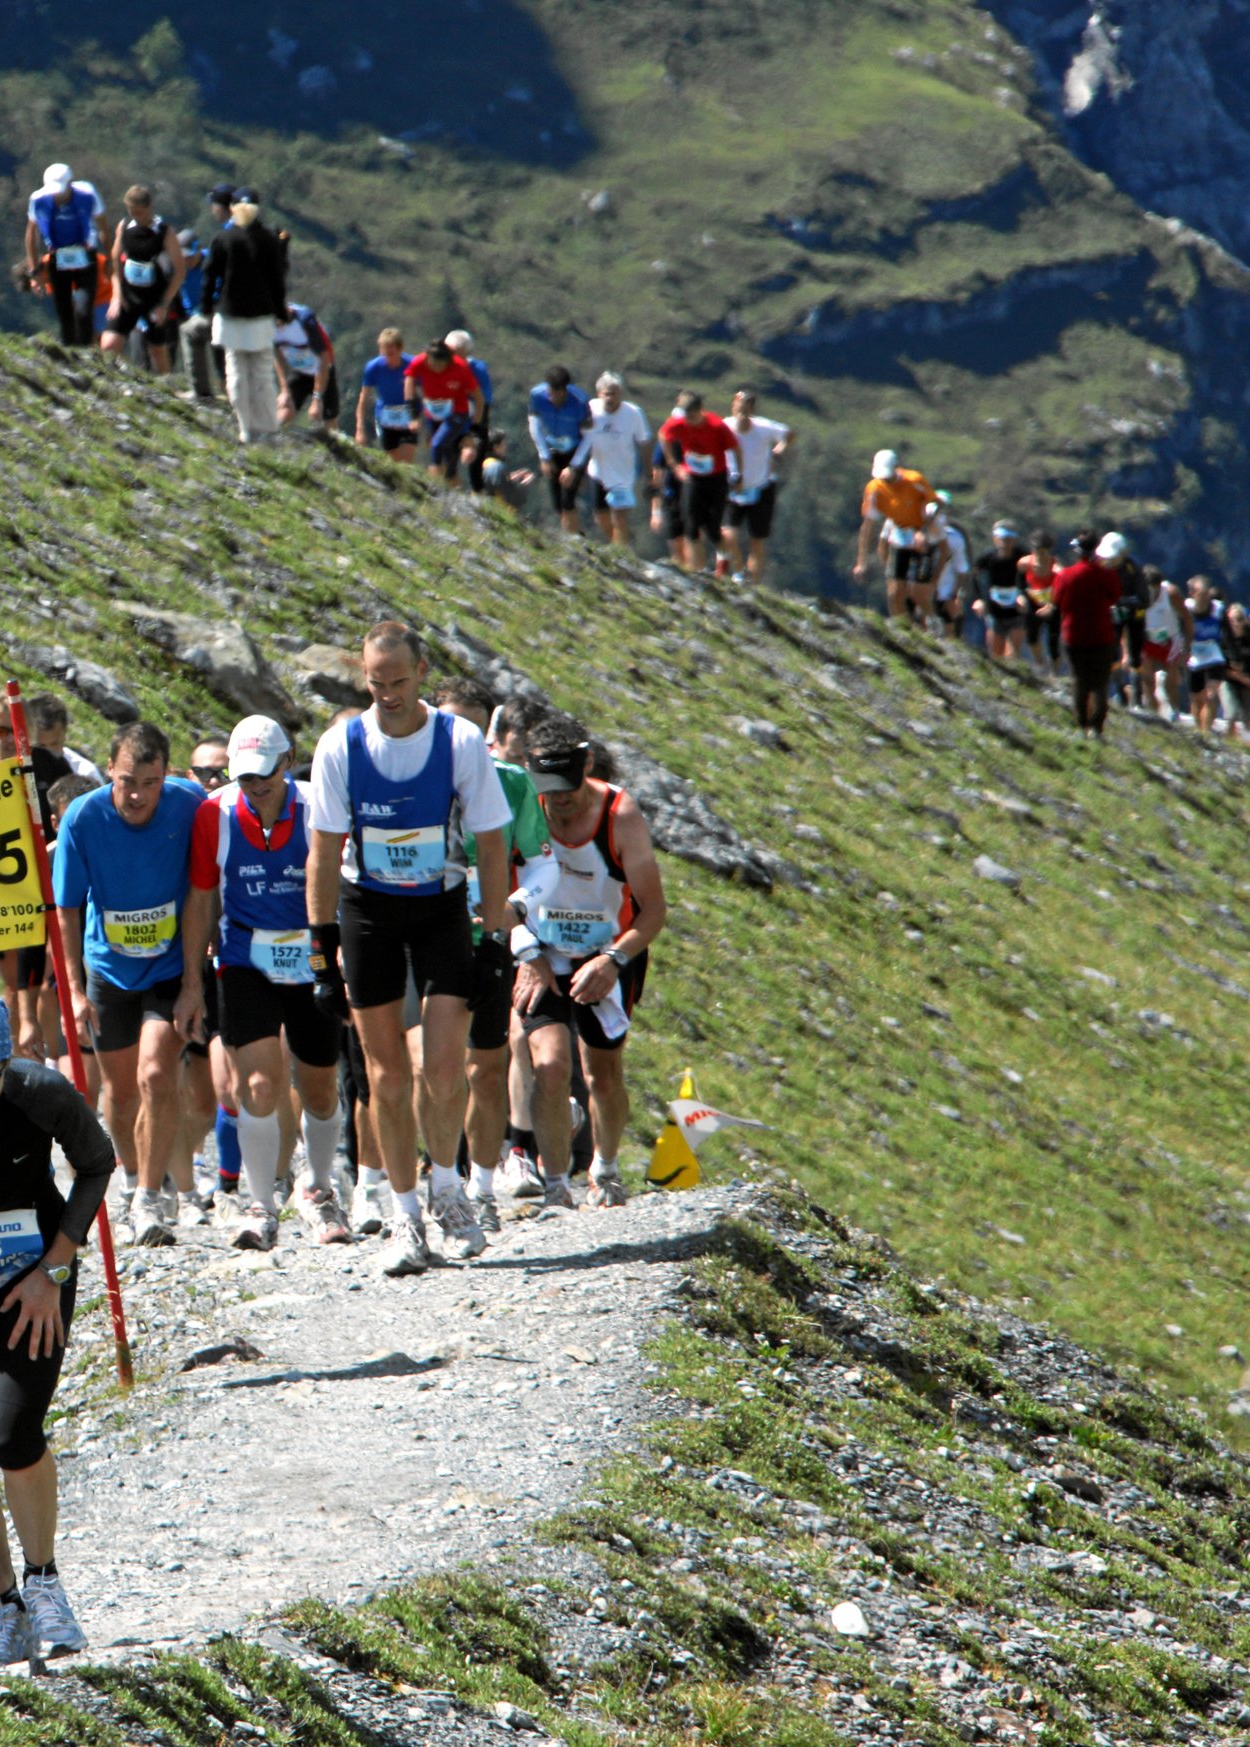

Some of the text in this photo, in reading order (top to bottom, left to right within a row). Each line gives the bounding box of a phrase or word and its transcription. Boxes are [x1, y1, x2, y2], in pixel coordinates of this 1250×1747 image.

[385, 846, 418, 858] 1116
[246, 881, 266, 896] LF
[114, 907, 167, 923] MIGROS
[547, 910, 604, 921] MIGROS
[14, 921, 35, 934] 144
[124, 924, 157, 935] 1802
[557, 922, 590, 934] 1422
[124, 934, 156, 945] MICHEL
[270, 946, 302, 958] 1572
[273, 958, 297, 968] KNUT
